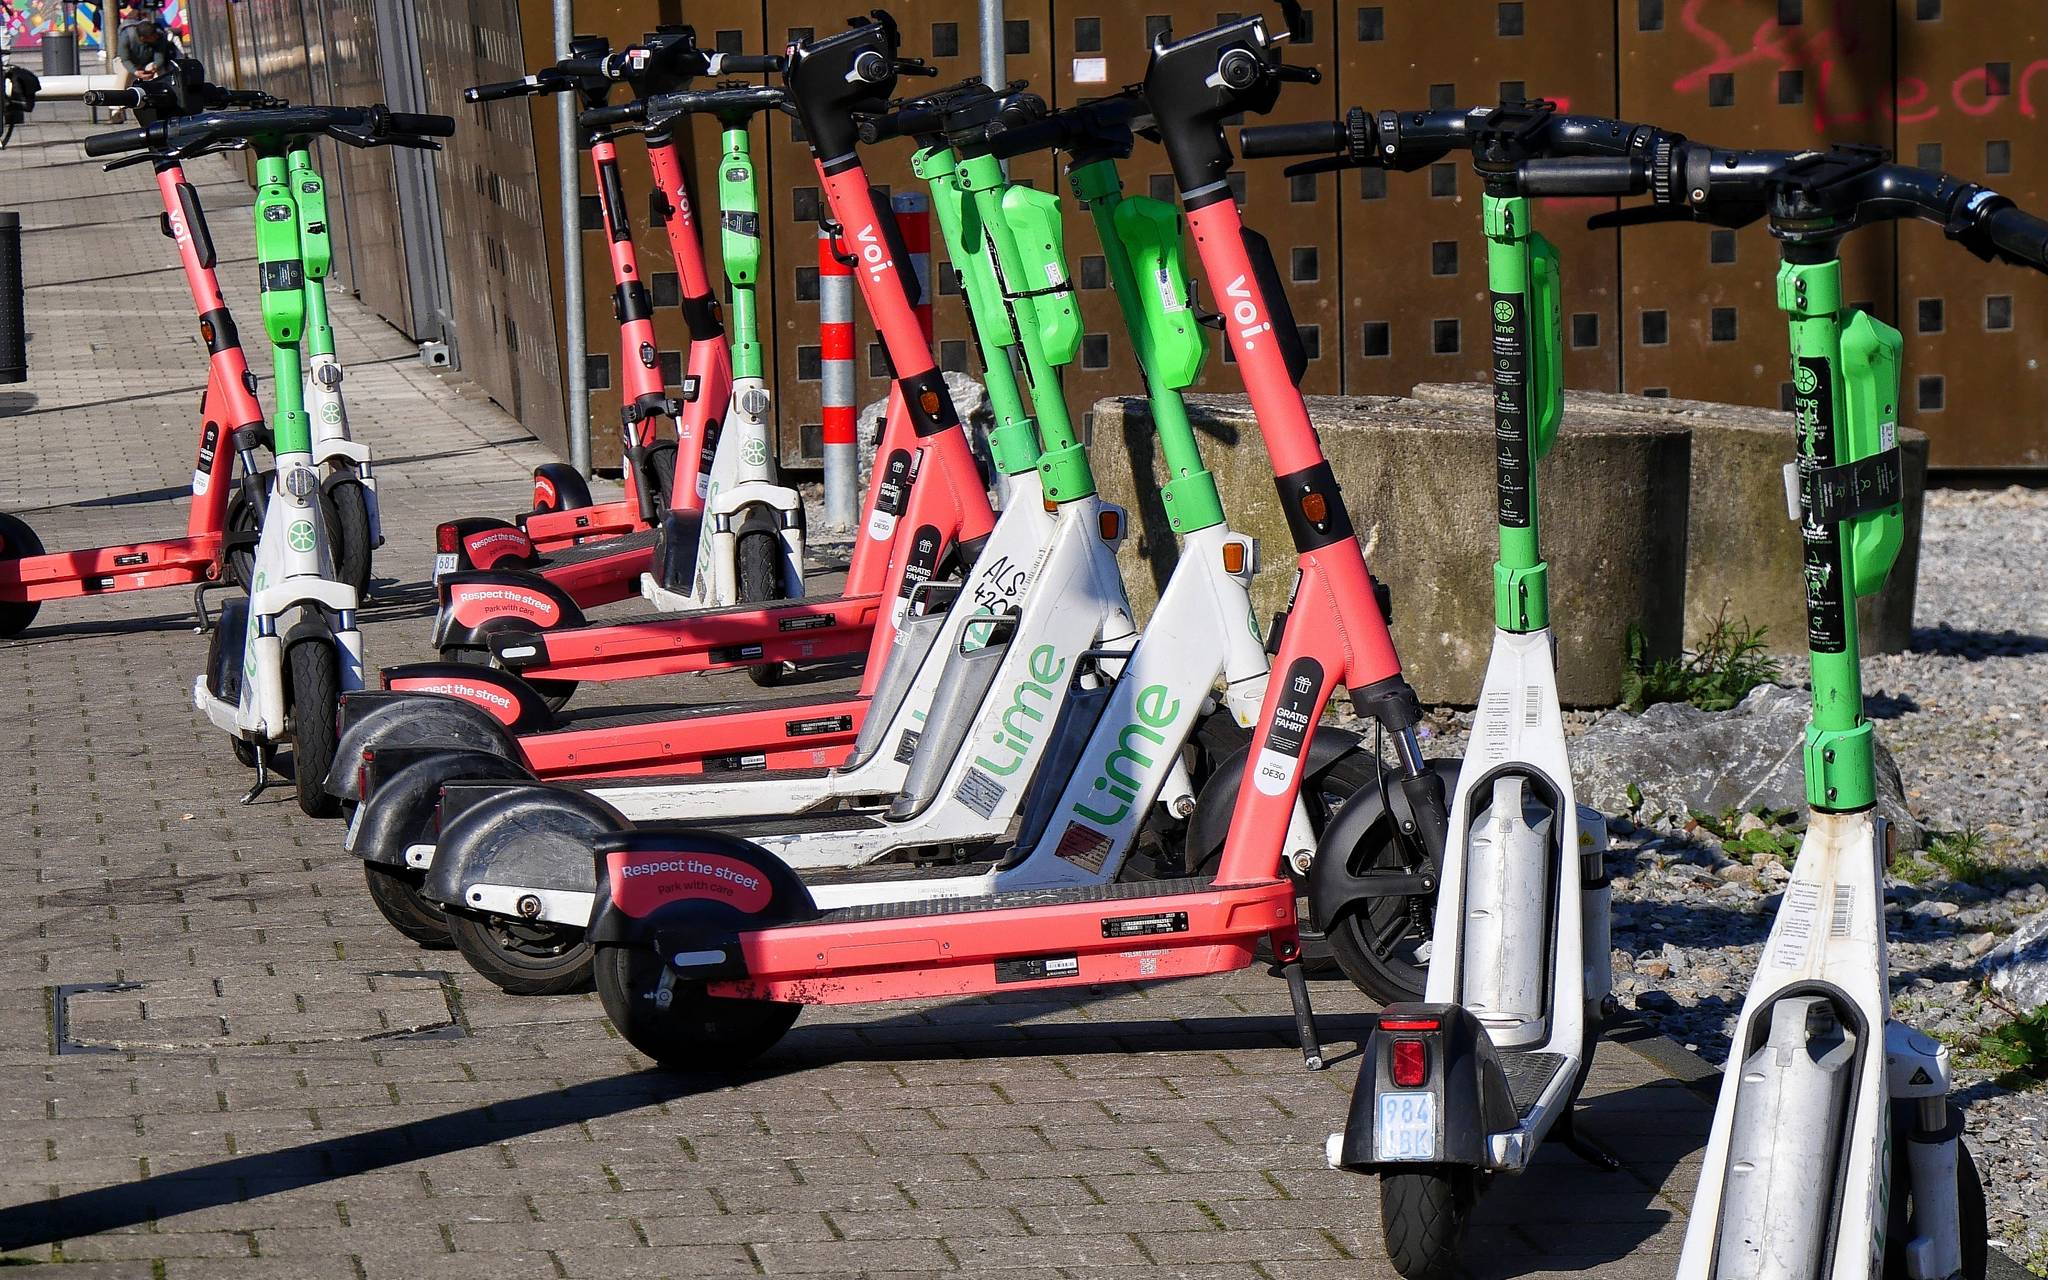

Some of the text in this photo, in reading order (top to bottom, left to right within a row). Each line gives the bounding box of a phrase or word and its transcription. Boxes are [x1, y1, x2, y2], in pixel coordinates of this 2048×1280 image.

[169, 208, 192, 250] voi.
[857, 223, 893, 283] voi.
[1226, 274, 1271, 350] voi.
[1494, 323, 1515, 334] Lime
[471, 533, 498, 551] Respect
[439, 557, 456, 569] 681
[906, 564, 932, 577] GRATIS
[460, 590, 552, 614] Respect the street
[454, 684, 475, 696] the
[475, 689, 511, 709] street
[1293, 701, 1298, 711] 1
[974, 644, 1066, 777] Lime
[1276, 707, 1309, 724] GRATIS
[1274, 717, 1305, 734] FAHRT
[1072, 684, 1181, 826] Lime
[622, 859, 760, 891] Respect the street
[657, 880, 734, 898] Park with care
[1386, 1097, 1428, 1124] 984
